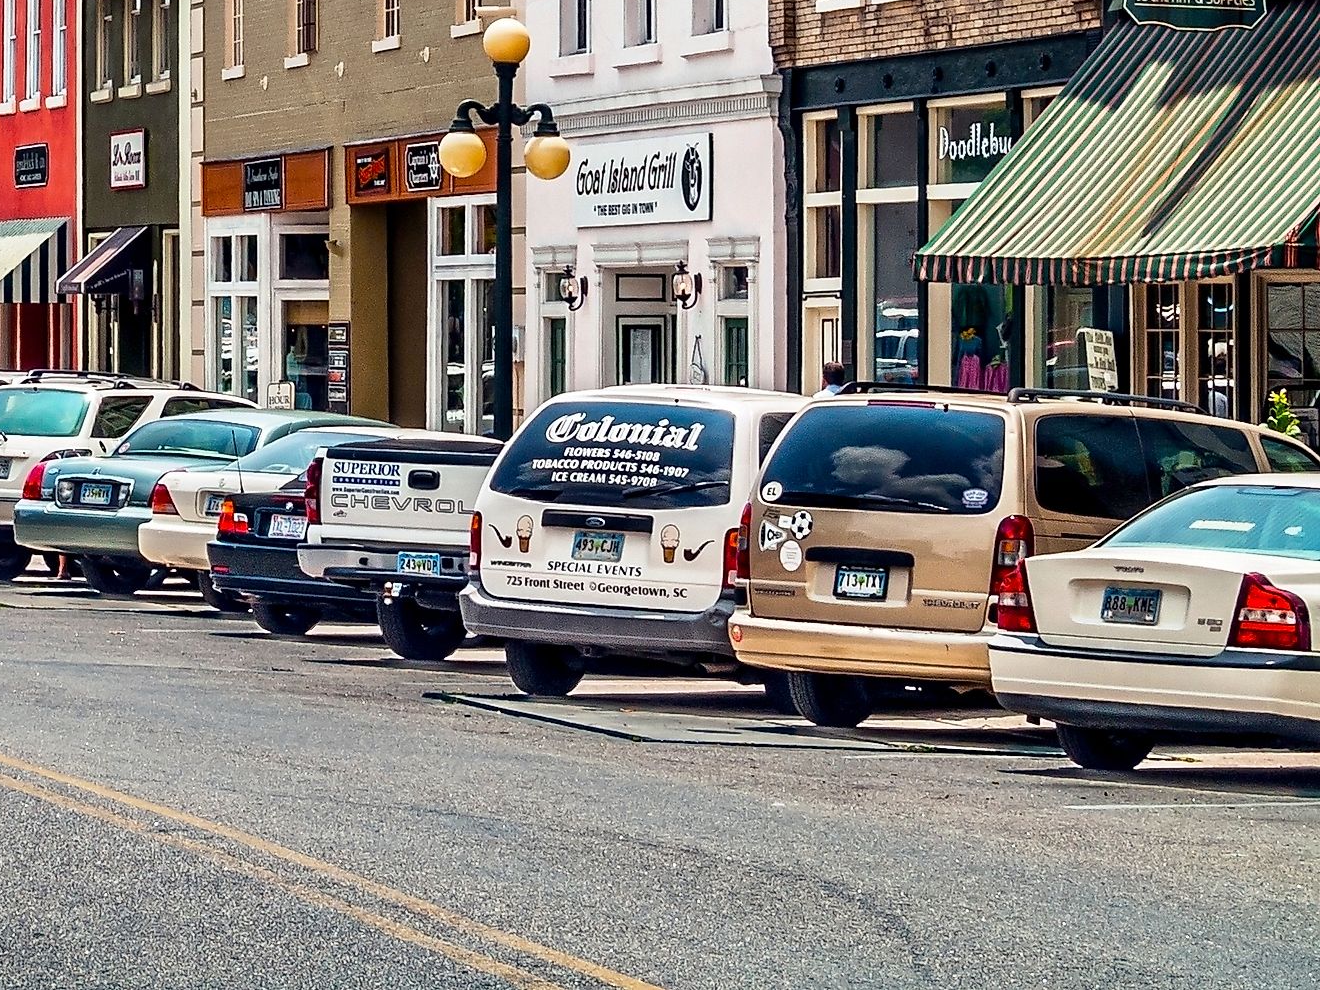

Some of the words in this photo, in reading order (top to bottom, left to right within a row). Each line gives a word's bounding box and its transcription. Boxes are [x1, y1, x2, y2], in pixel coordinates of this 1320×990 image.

[576, 158, 606, 196] Goat
[607, 154, 647, 194] Island
[648, 151, 678, 191] Grill
[608, 203, 621, 216] BEST
[631, 202, 638, 215] IN
[268, 395, 290, 405] HOUR
[545, 412, 706, 452] Colonial
[563, 446, 611, 459] FLOWERS
[612, 448, 661, 462] 546-5108
[333, 461, 401, 477] SUPERIOR
[532, 458, 580, 470] TOBACCO
[580, 459, 639, 473] PRODUCTS
[639, 463, 690, 479] 546-1907
[551, 471, 569, 482] ICE
[569, 471, 607, 484] CREAM
[608, 473, 658, 488] 545-9708
[766, 487, 777, 496] EL
[600, 539, 620, 553] CJH
[400, 558, 417, 570] 243
[547, 560, 592, 574] SPECIAL
[596, 563, 643, 577] EVENTS
[506, 575, 523, 586] 725
[524, 576, 551, 589] Front
[553, 578, 585, 591] Street
[597, 582, 670, 598] Georgetown,
[673, 587, 688, 598] SC
[839, 572, 858, 588] 713
[865, 573, 885, 589] TXY
